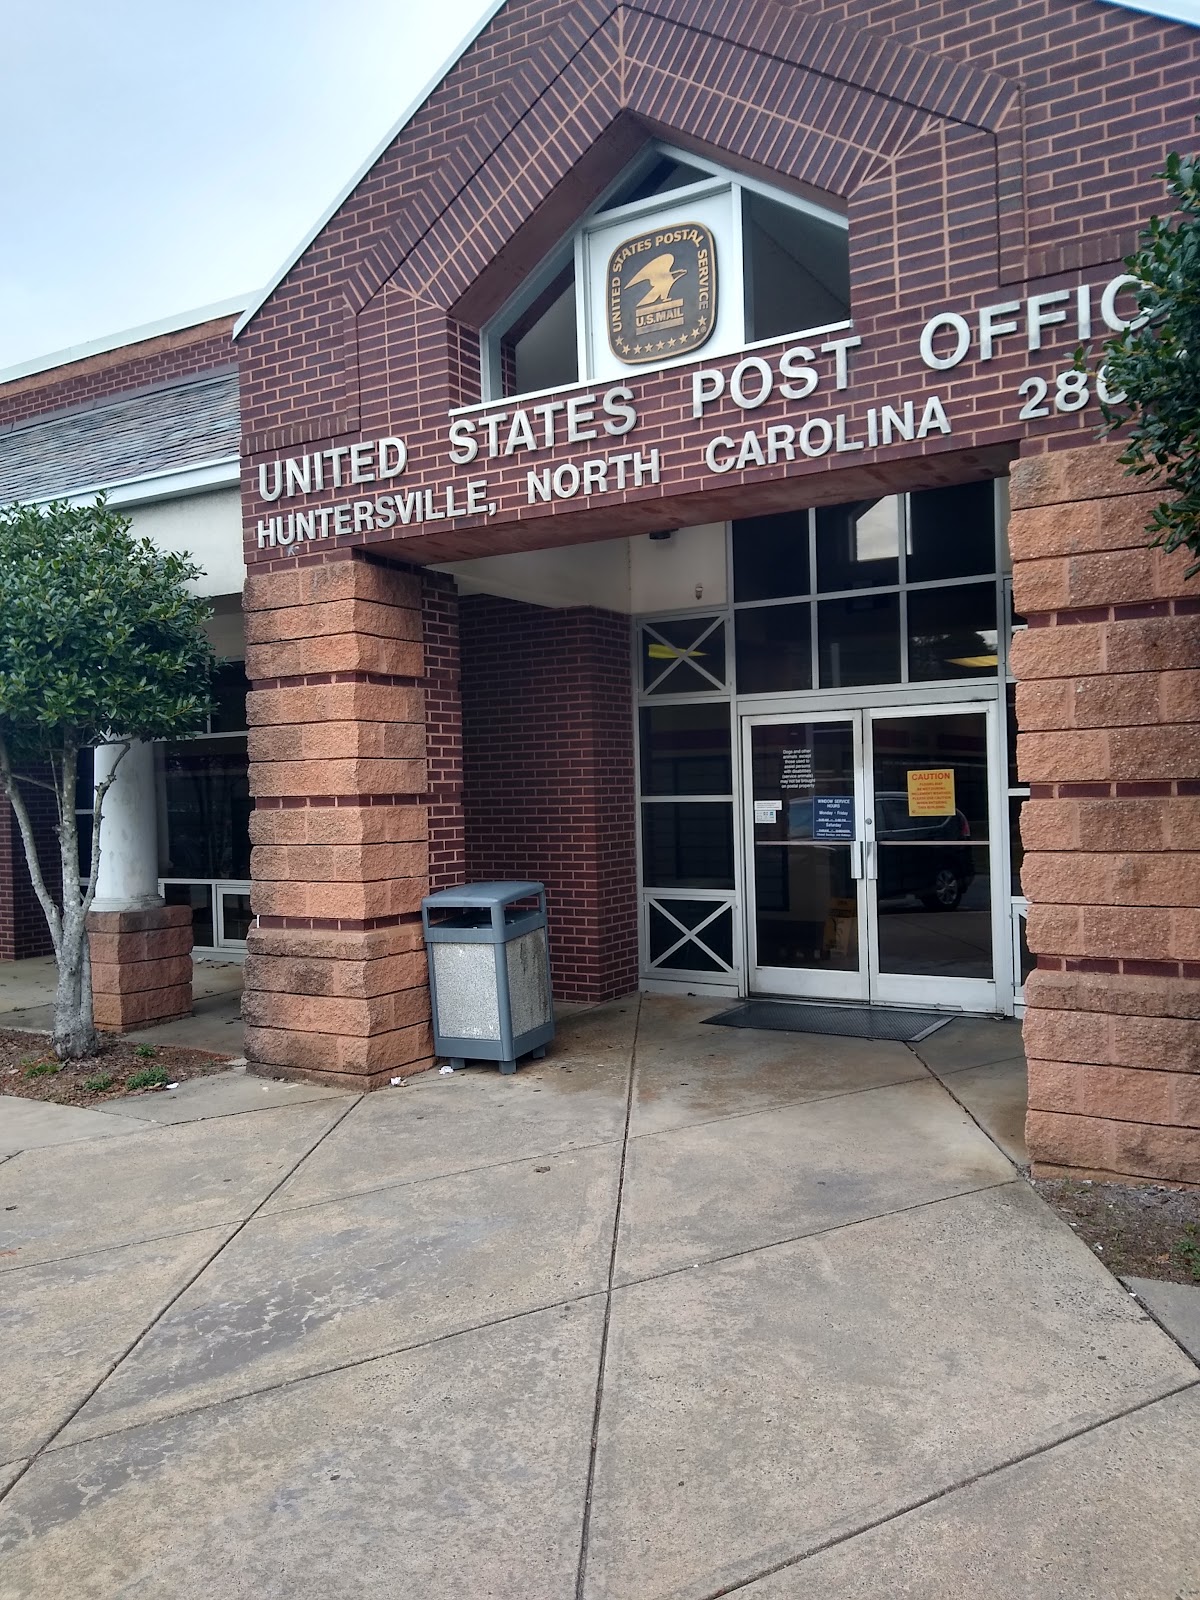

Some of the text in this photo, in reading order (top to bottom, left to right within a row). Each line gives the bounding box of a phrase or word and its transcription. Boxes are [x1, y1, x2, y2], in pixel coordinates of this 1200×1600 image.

[612, 229, 709, 333] UNITED STATES POSTAL SERVICE
[257, 363, 1129, 550] HUNTERSVILLE, NORTH CAROLINA 280
[258, 273, 1154, 503] UNITED STATES POST OFFIC
[911, 772, 950, 780] CAUTION
